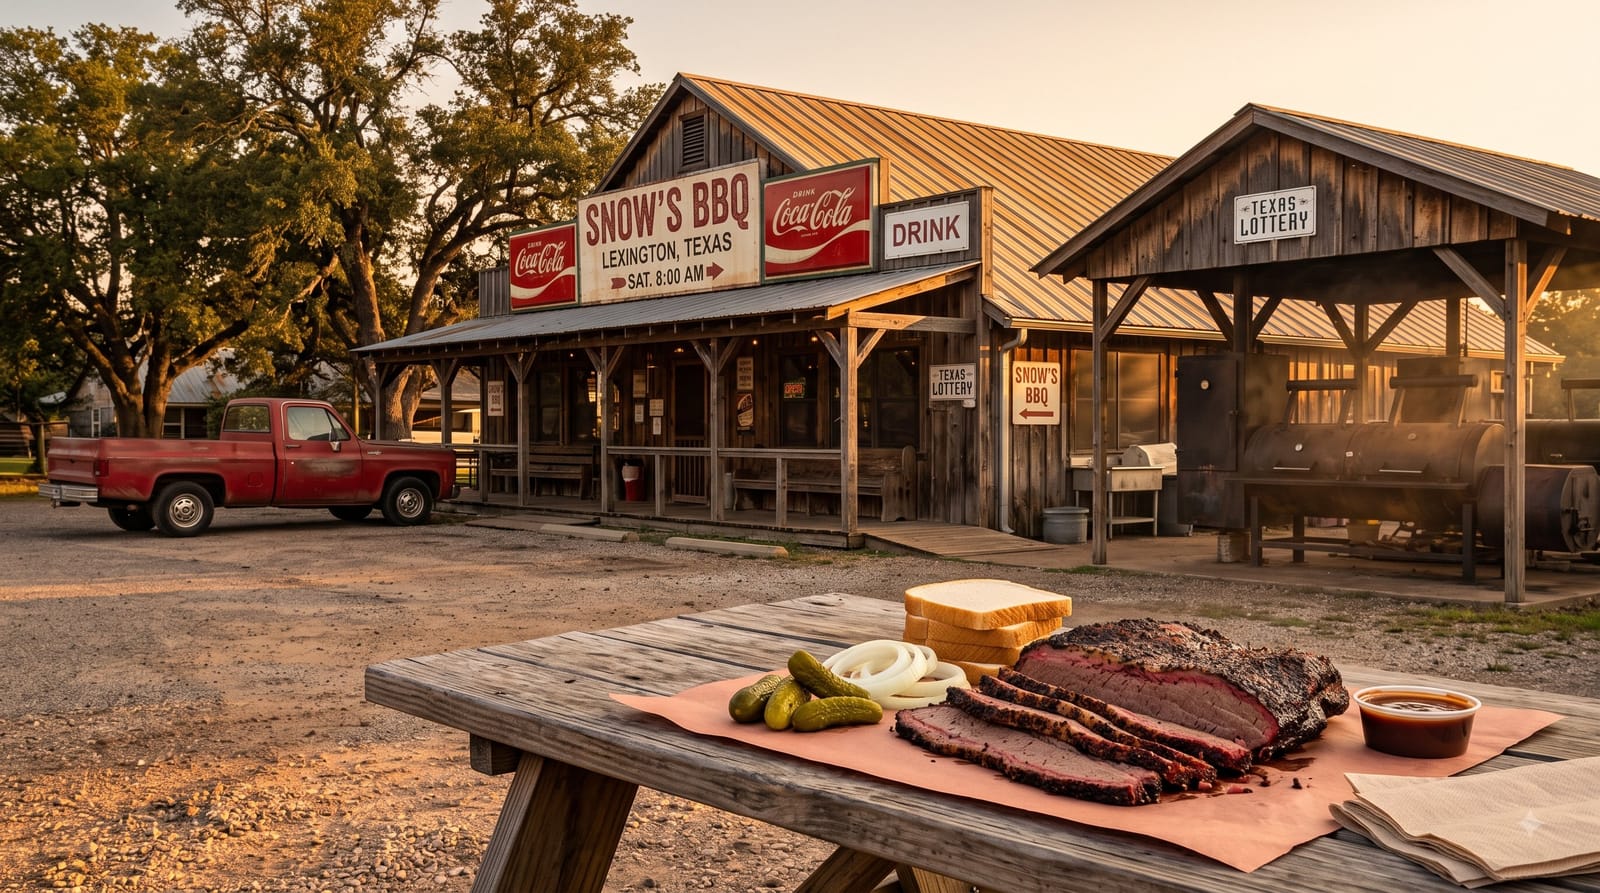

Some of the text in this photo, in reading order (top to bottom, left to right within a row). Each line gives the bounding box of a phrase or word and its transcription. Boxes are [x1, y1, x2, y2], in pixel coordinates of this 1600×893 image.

[793, 188, 816, 199] DRINK
[1251, 196, 1296, 215] TEXAS
[587, 173, 749, 246] SNOW'S BBQ
[772, 186, 856, 237] Coca-Cola
[893, 215, 960, 247] DRINK
[1241, 211, 1308, 236] LOTTERY
[515, 241, 566, 277] Coca-Cola
[602, 232, 732, 269] LEXINGTON, TEXAS
[627, 266, 704, 290] SAT. 8:00 AM
[939, 369, 966, 380] TEXAS
[1015, 366, 1058, 384] SNOW'S
[932, 382, 973, 395] LOTTERY
[1026, 387, 1048, 407] BBQ
